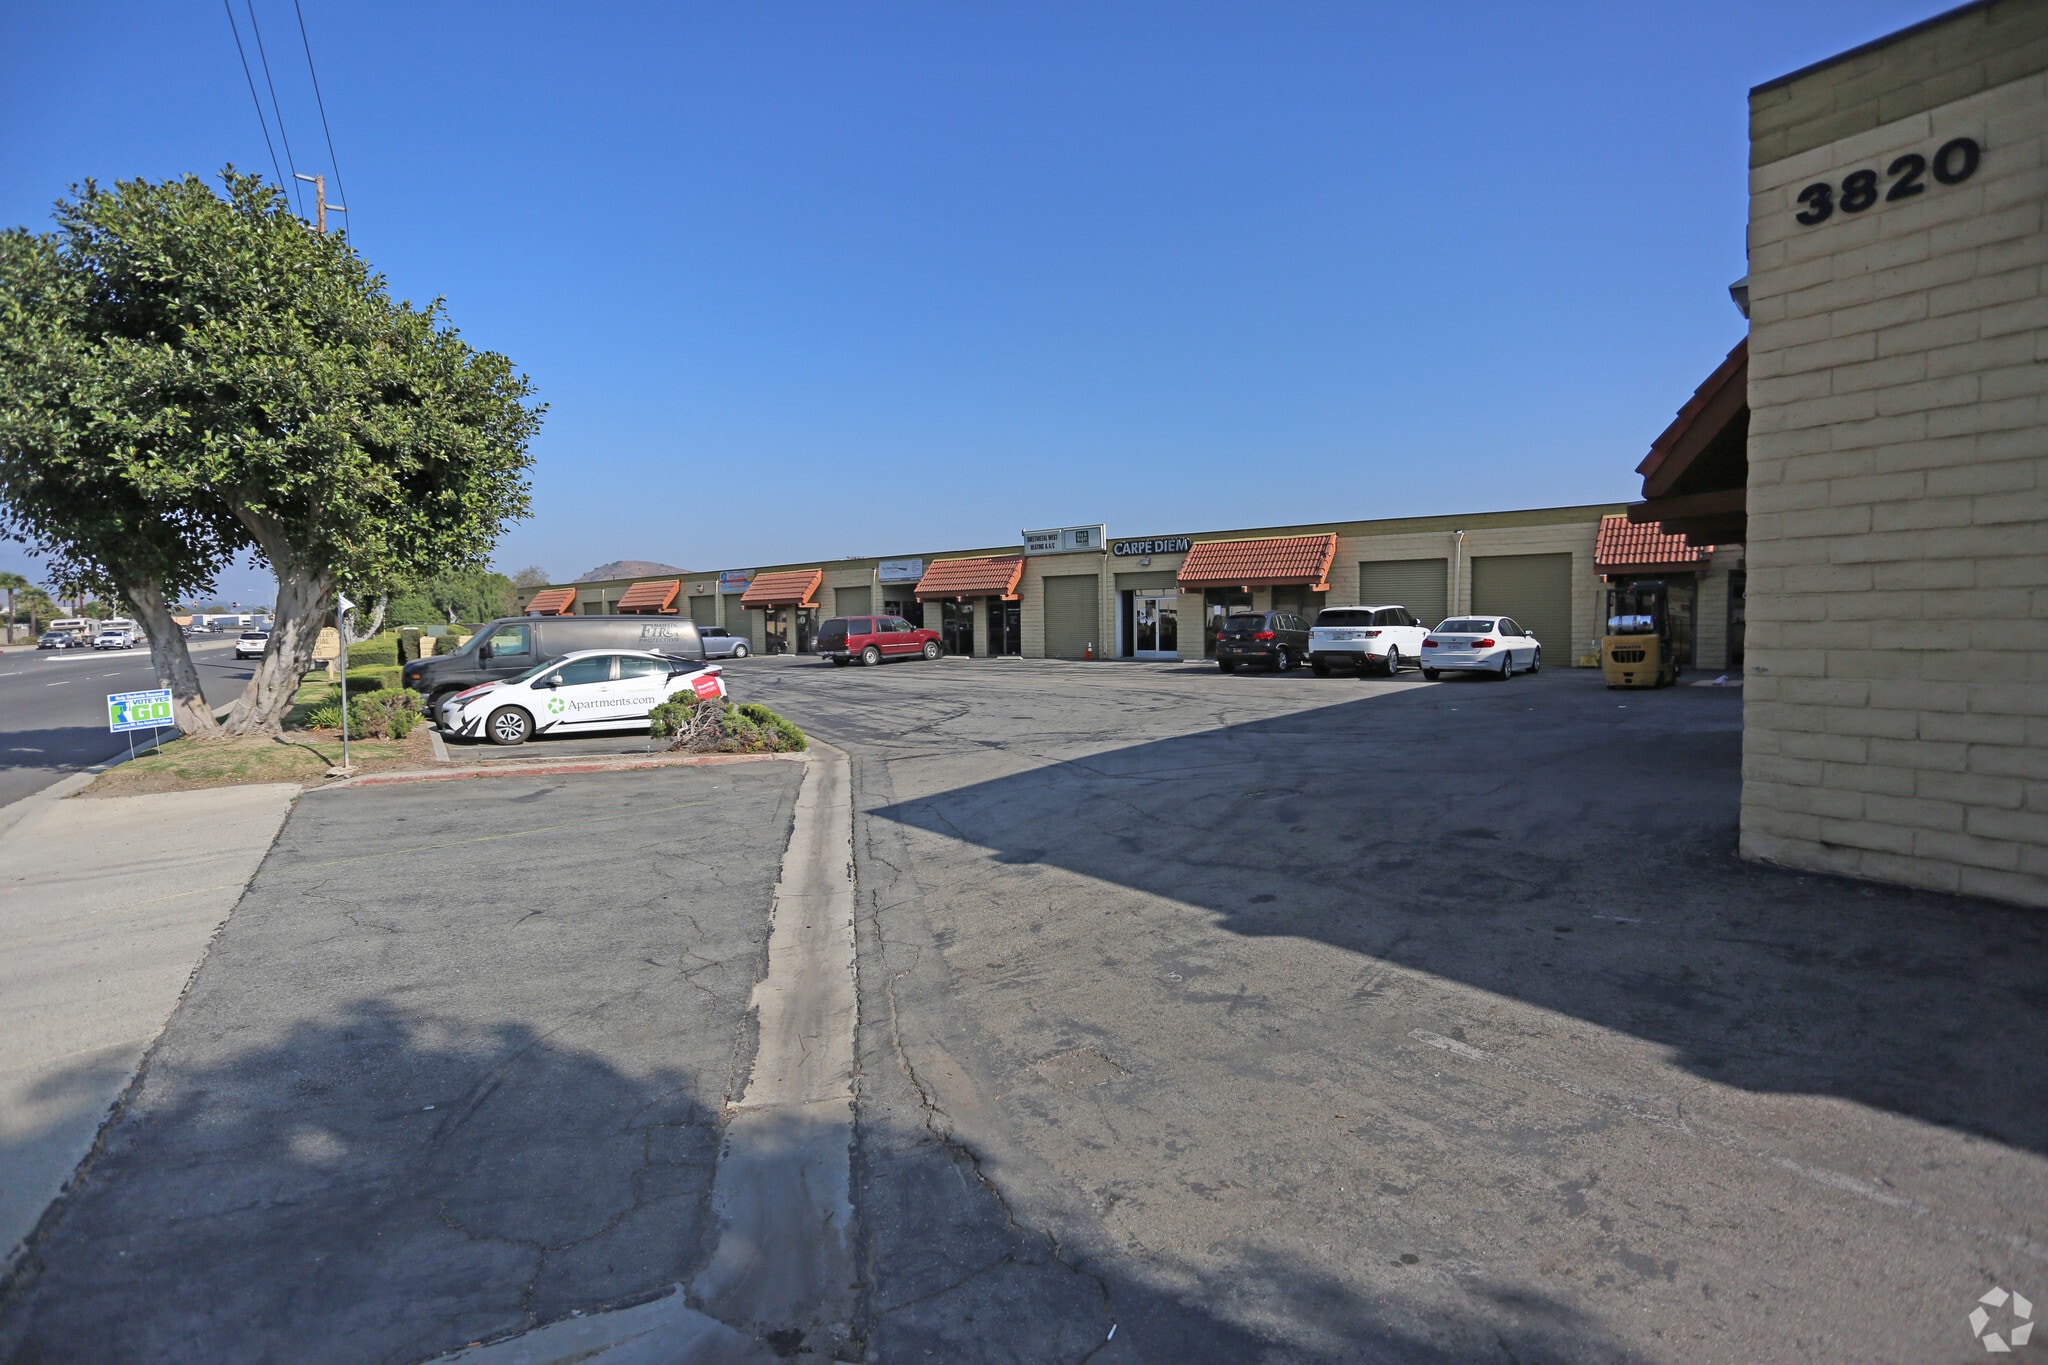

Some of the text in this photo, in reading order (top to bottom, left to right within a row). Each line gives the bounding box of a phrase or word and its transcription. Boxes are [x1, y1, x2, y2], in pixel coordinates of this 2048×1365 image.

[1795, 137, 1982, 226] 3820
[1113, 538, 1188, 555] CARPE DIEM
[131, 702, 170, 720] GO
[568, 696, 655, 711] Apartments.com
